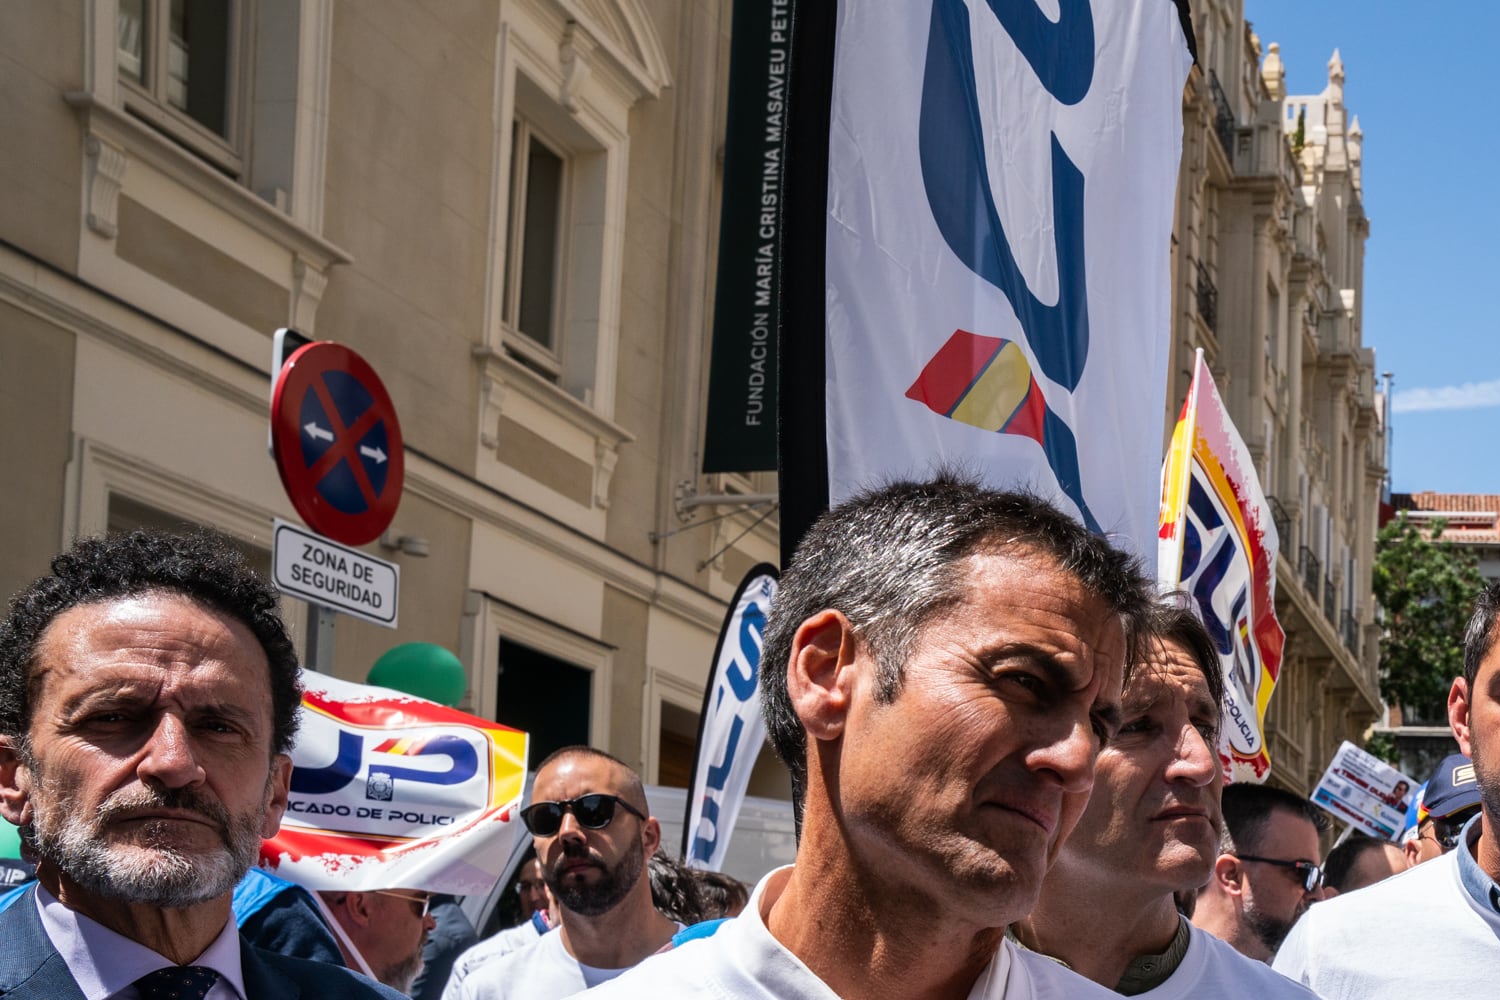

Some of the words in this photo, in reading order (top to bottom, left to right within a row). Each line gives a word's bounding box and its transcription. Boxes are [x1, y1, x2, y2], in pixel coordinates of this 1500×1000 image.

[766, 48, 786, 142] MASAVEU
[759, 148, 781, 239] CRISTINA
[754, 243, 775, 306] MARÍA
[745, 312, 770, 426] FUNDACIÓN
[291, 563, 383, 609] SEGURIDAD
[302, 543, 348, 575] ZONA
[353, 562, 374, 584] DE
[287, 728, 479, 801] UP
[286, 800, 351, 816] ICADO
[356, 806, 383, 820] DE
